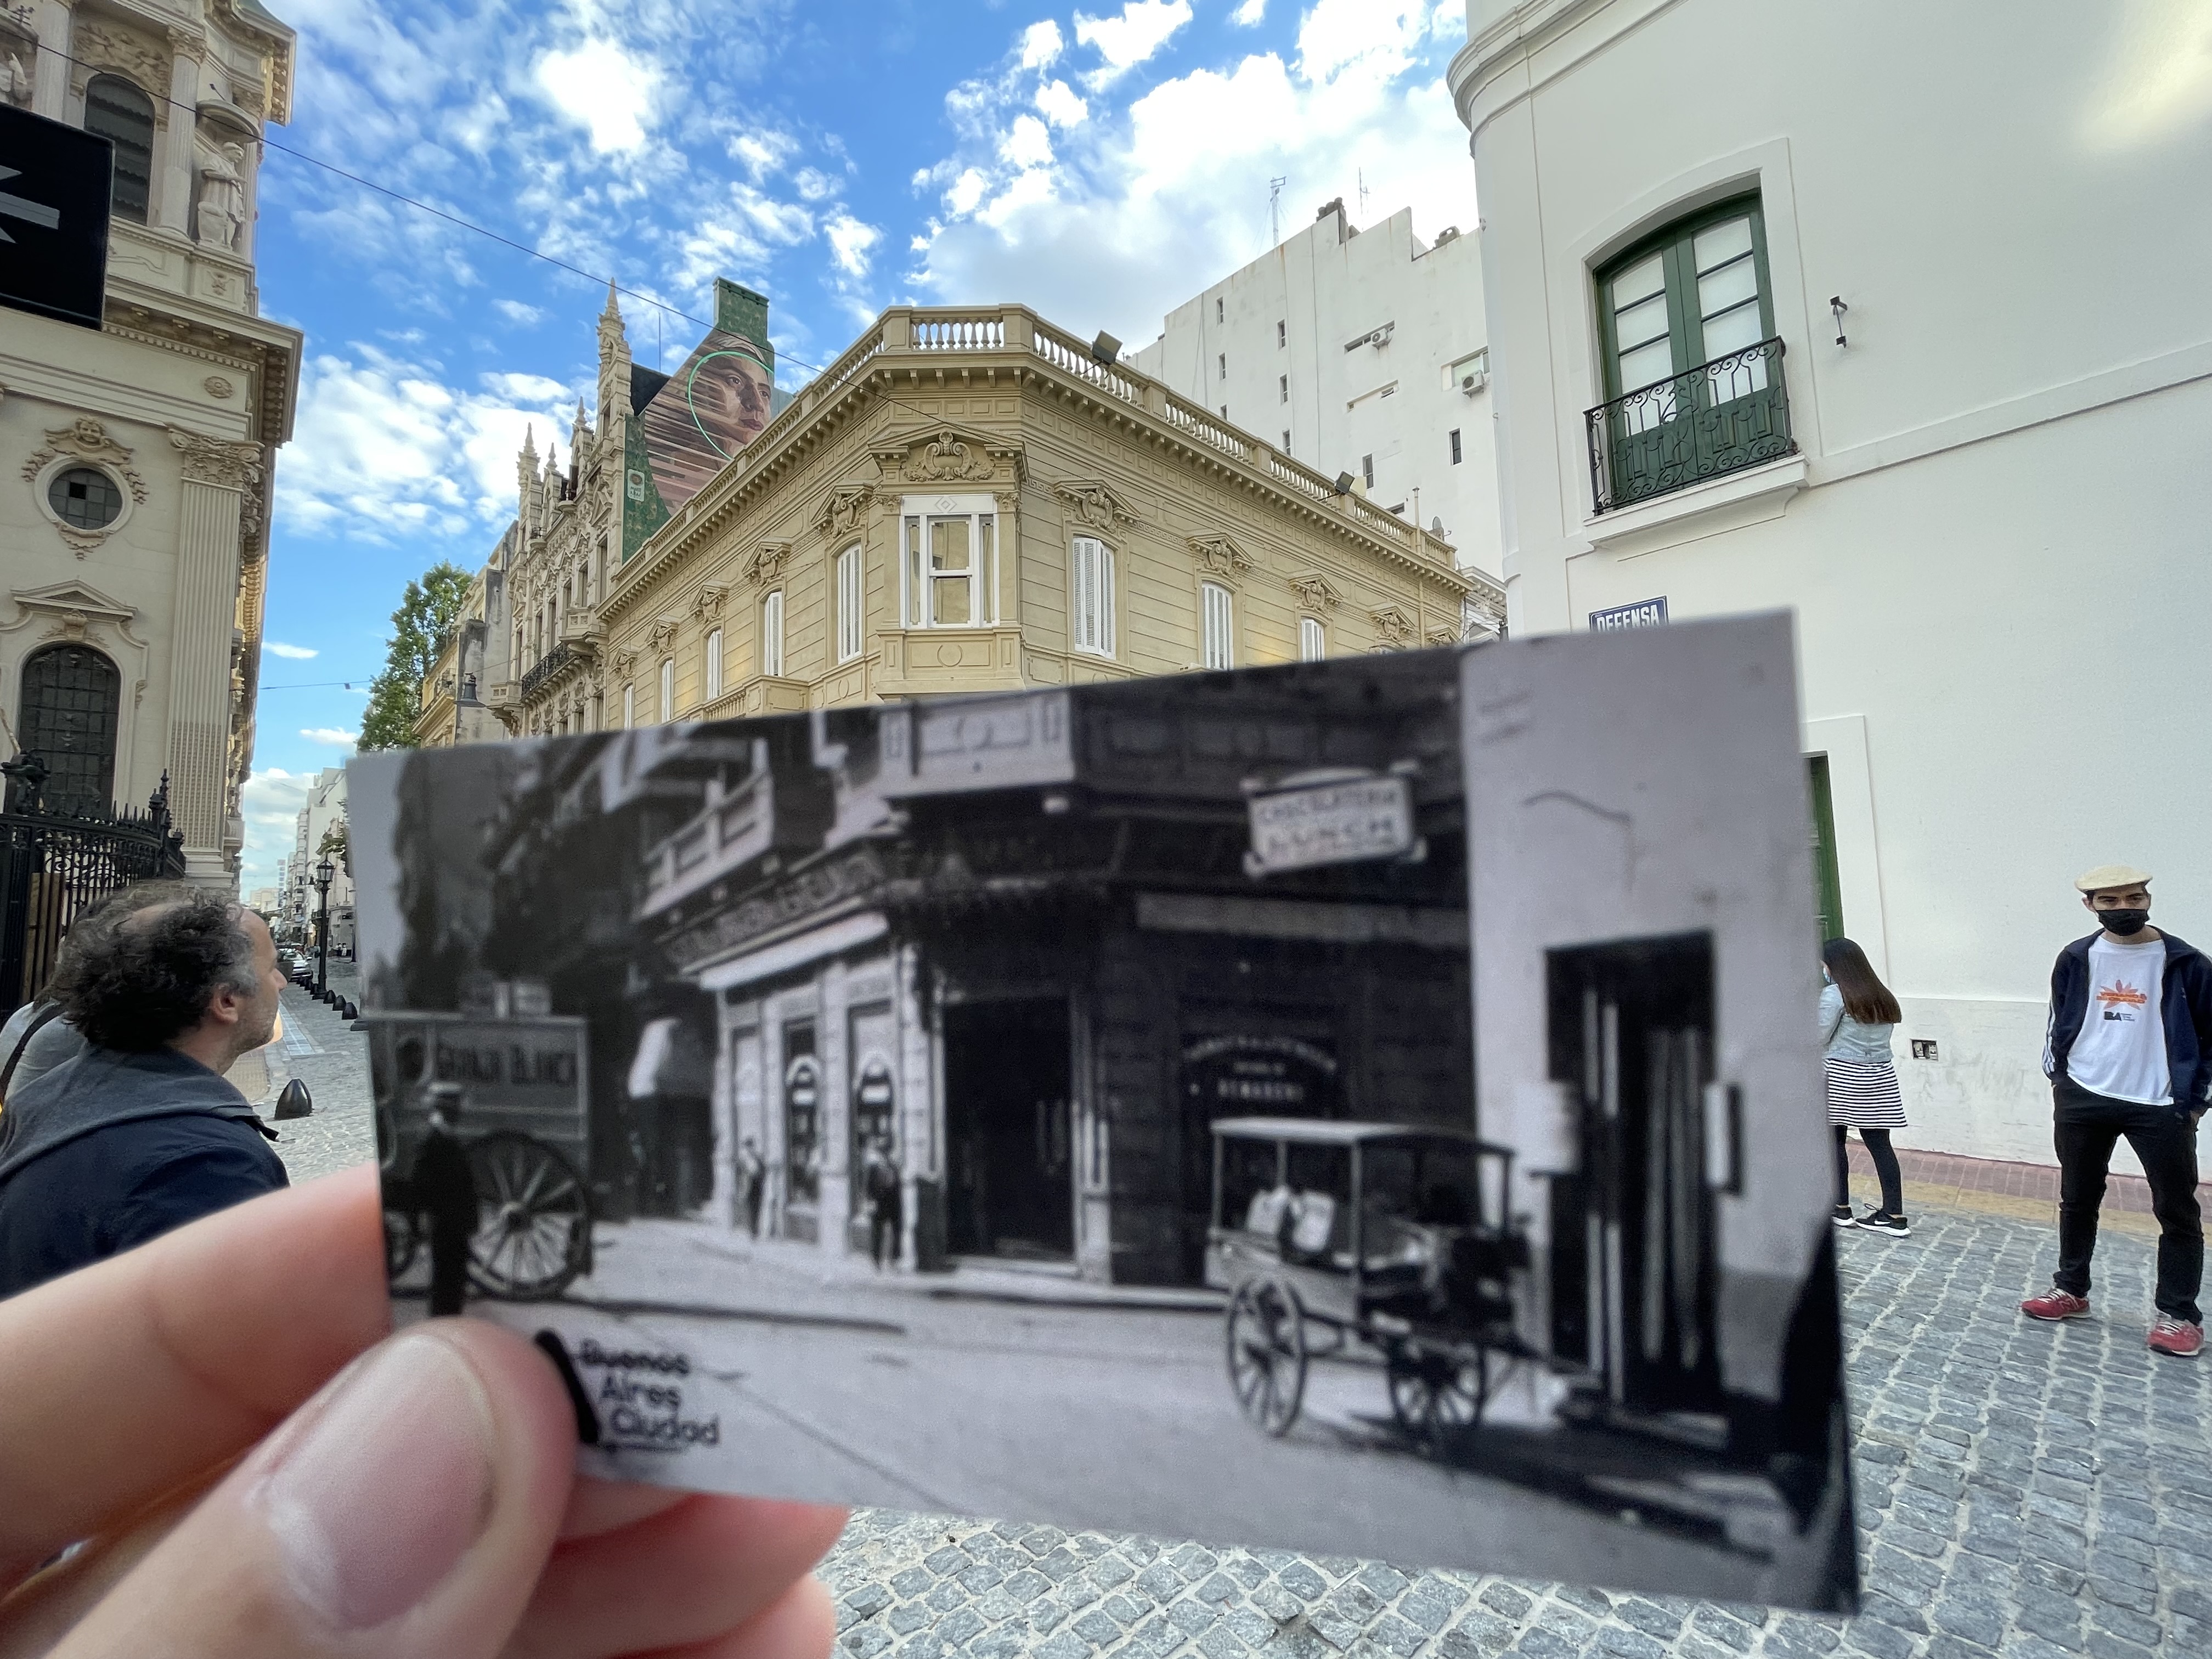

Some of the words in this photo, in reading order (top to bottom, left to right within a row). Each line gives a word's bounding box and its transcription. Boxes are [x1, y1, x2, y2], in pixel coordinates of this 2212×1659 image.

[1596, 604, 1660, 631] DEFENSA
[580, 1338, 689, 1376] Buenos
[601, 1373, 681, 1407] Aires
[610, 1404, 720, 1446] Ciudad
